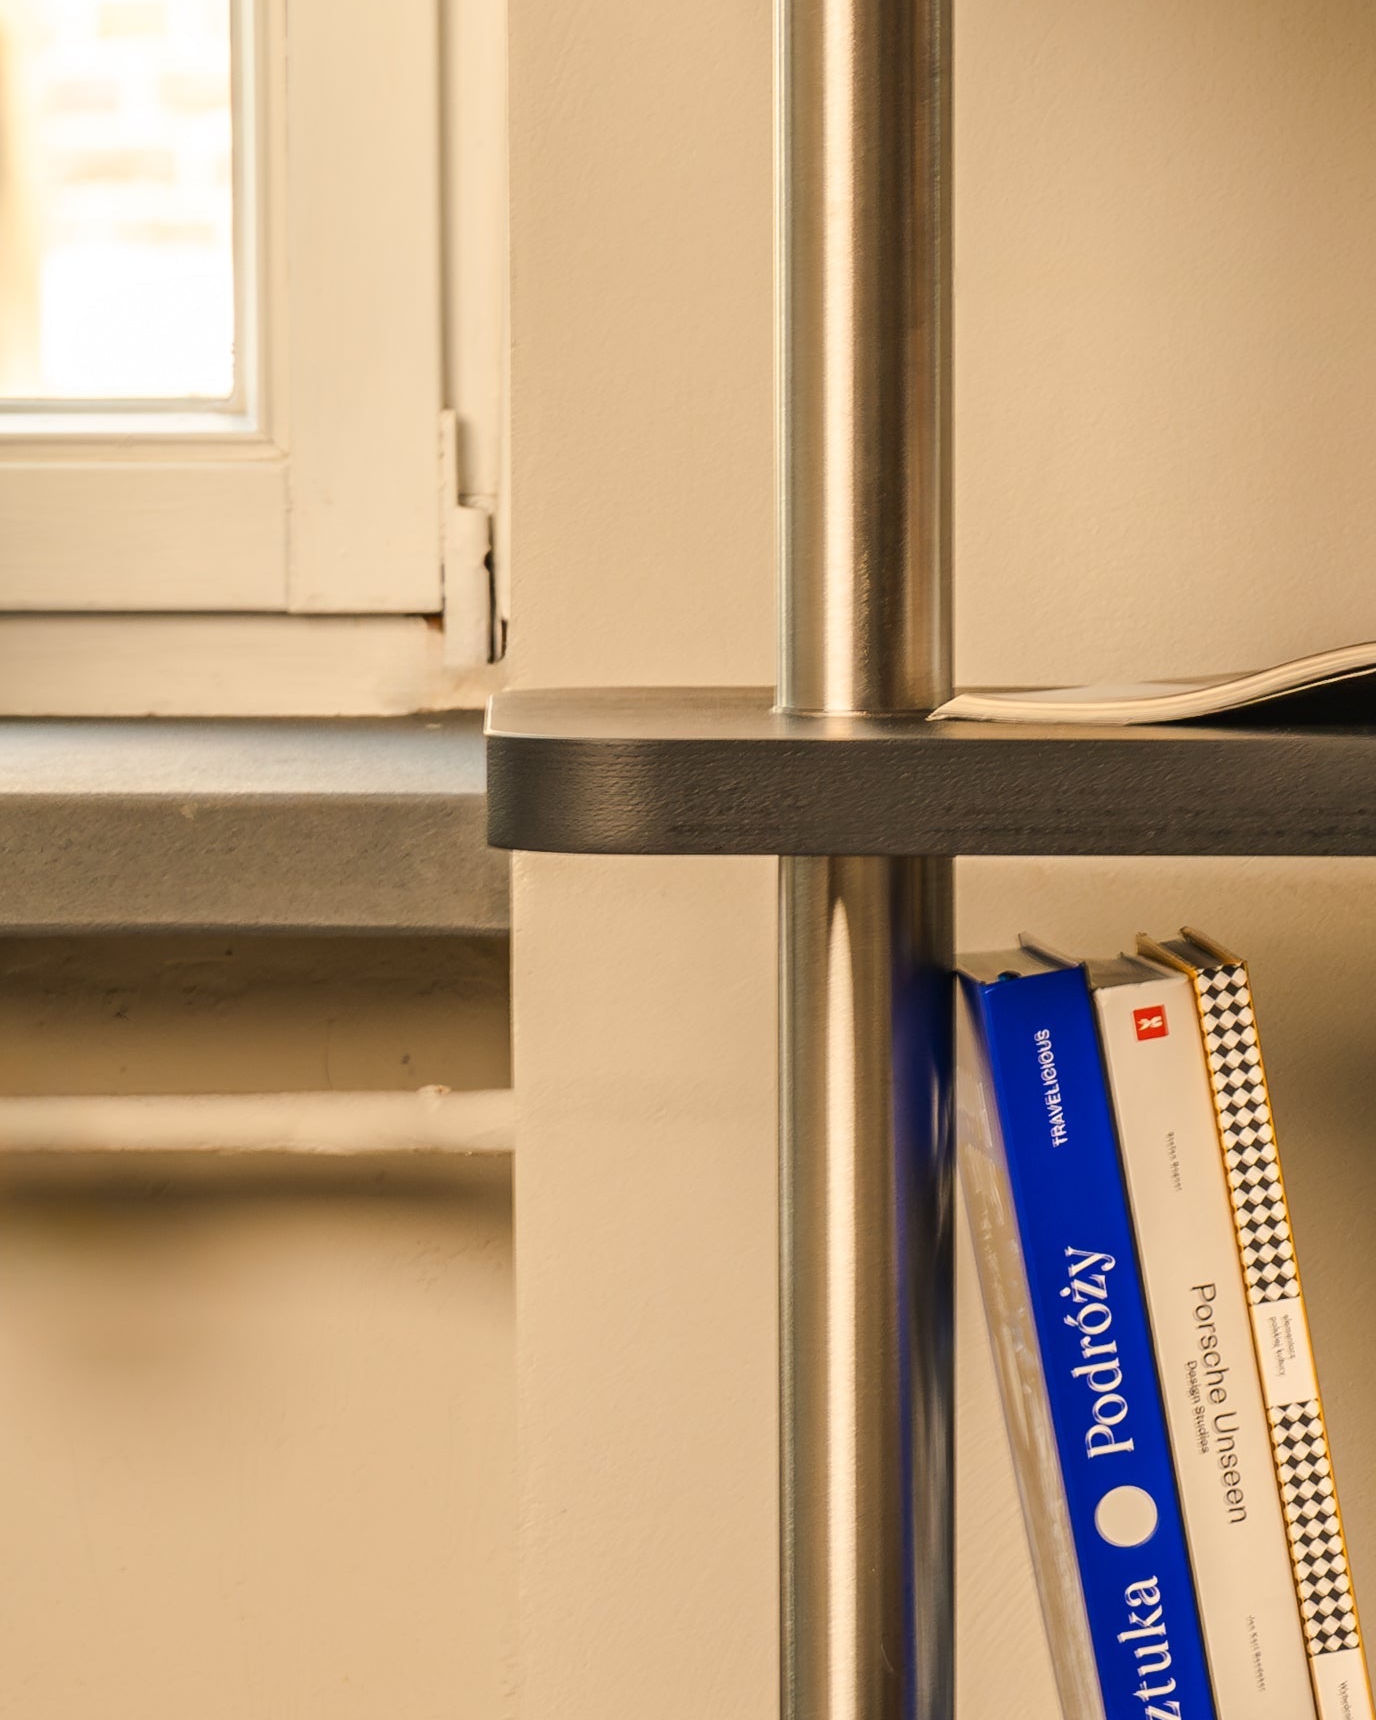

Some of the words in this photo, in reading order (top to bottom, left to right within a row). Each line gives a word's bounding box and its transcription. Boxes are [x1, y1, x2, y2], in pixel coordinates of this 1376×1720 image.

[1034, 1029, 1068, 1147] TRAVELICIOUS
[1059, 1246, 1135, 1459] Podróży
[1186, 1359, 1201, 1404] Design
[1194, 1405, 1210, 1454] Studies
[1190, 1282, 1230, 1405] Porsche
[1212, 1410, 1248, 1524] Unseen
